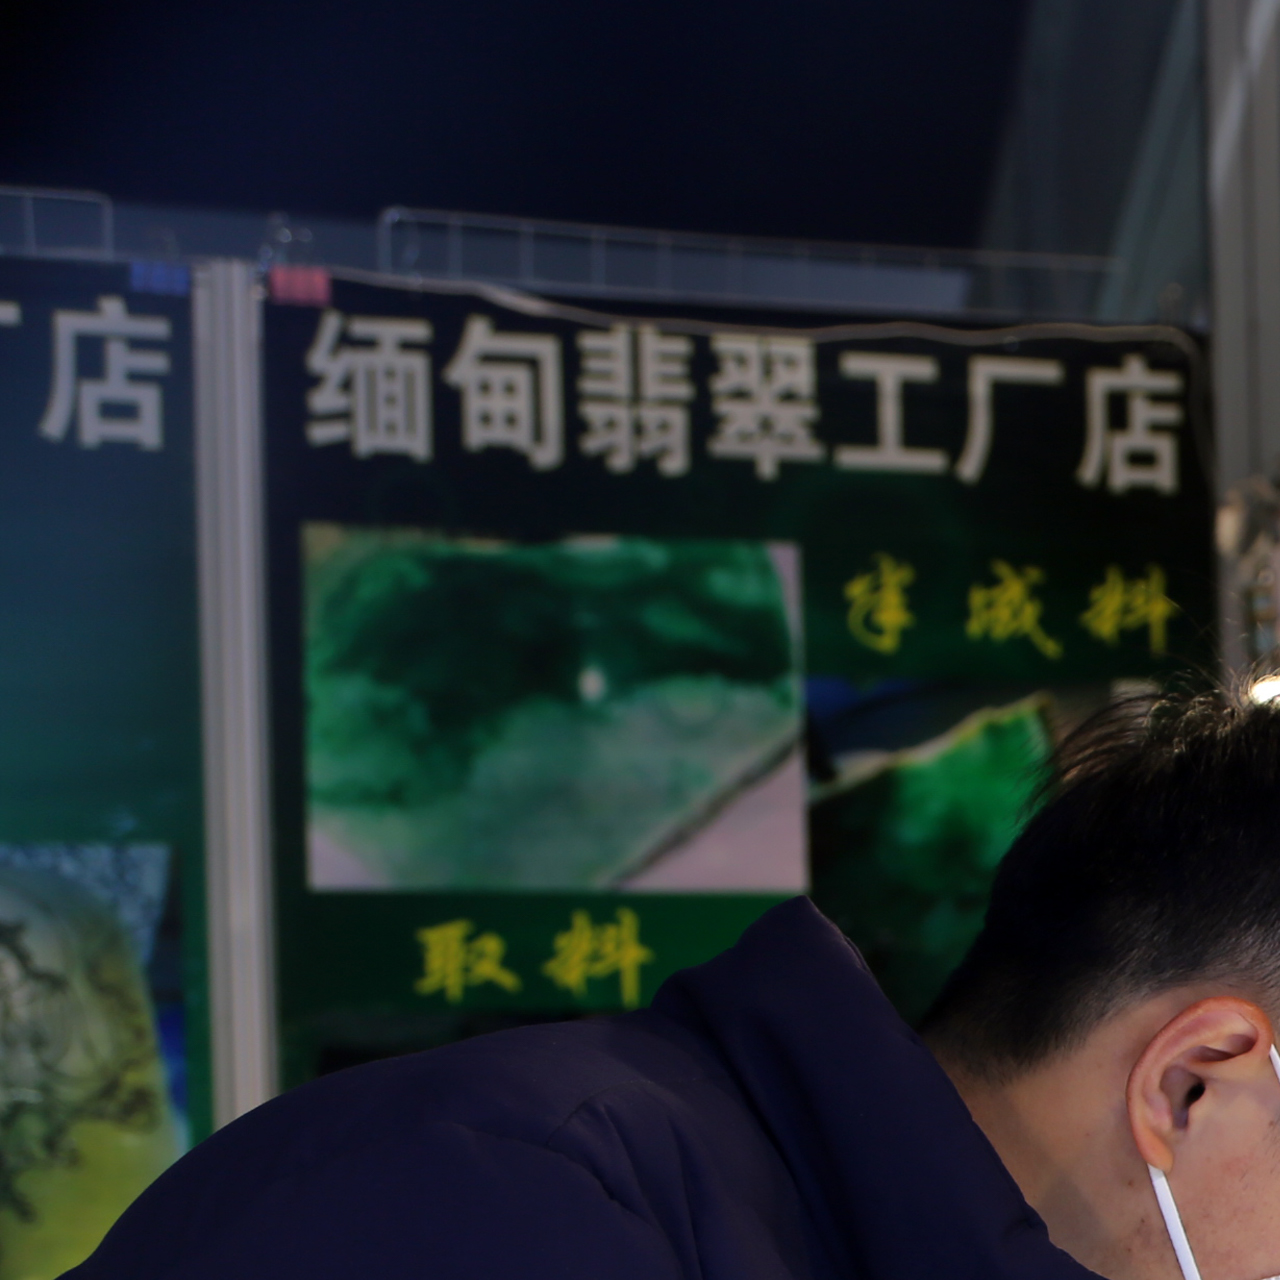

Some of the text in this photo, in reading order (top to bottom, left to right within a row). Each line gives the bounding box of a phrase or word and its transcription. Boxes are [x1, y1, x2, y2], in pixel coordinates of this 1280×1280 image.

[305, 310, 1184, 494] 缅甸翡翠工厂店
[414, 907, 654, 1009] 取料
